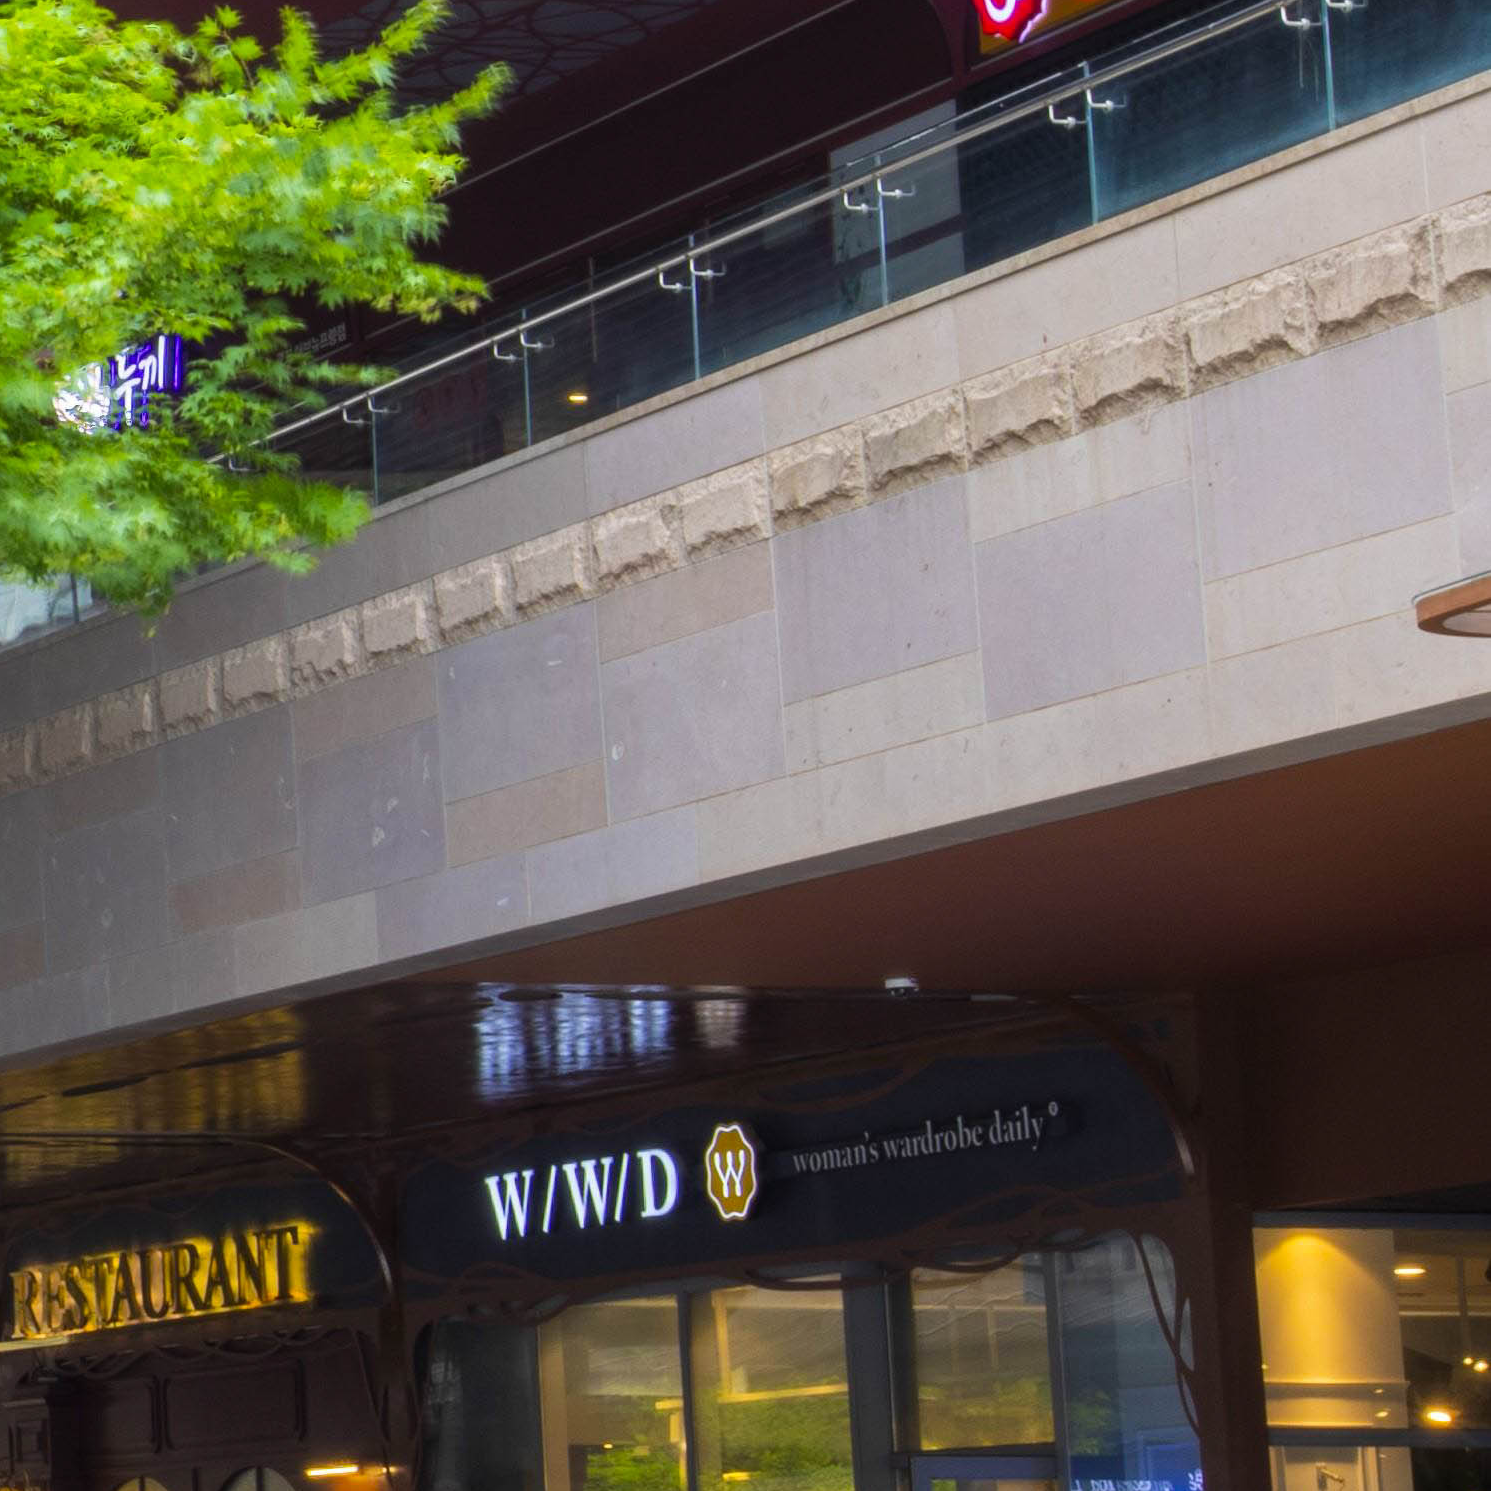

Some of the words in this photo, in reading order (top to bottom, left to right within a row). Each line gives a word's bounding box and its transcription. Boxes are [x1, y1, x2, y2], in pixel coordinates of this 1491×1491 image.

[792, 1131, 879, 1173] woman's
[883, 1115, 984, 1160] wardrobe
[485, 1148, 678, 1241] W/W/D
[10, 1225, 300, 1339] RESTAURANT
